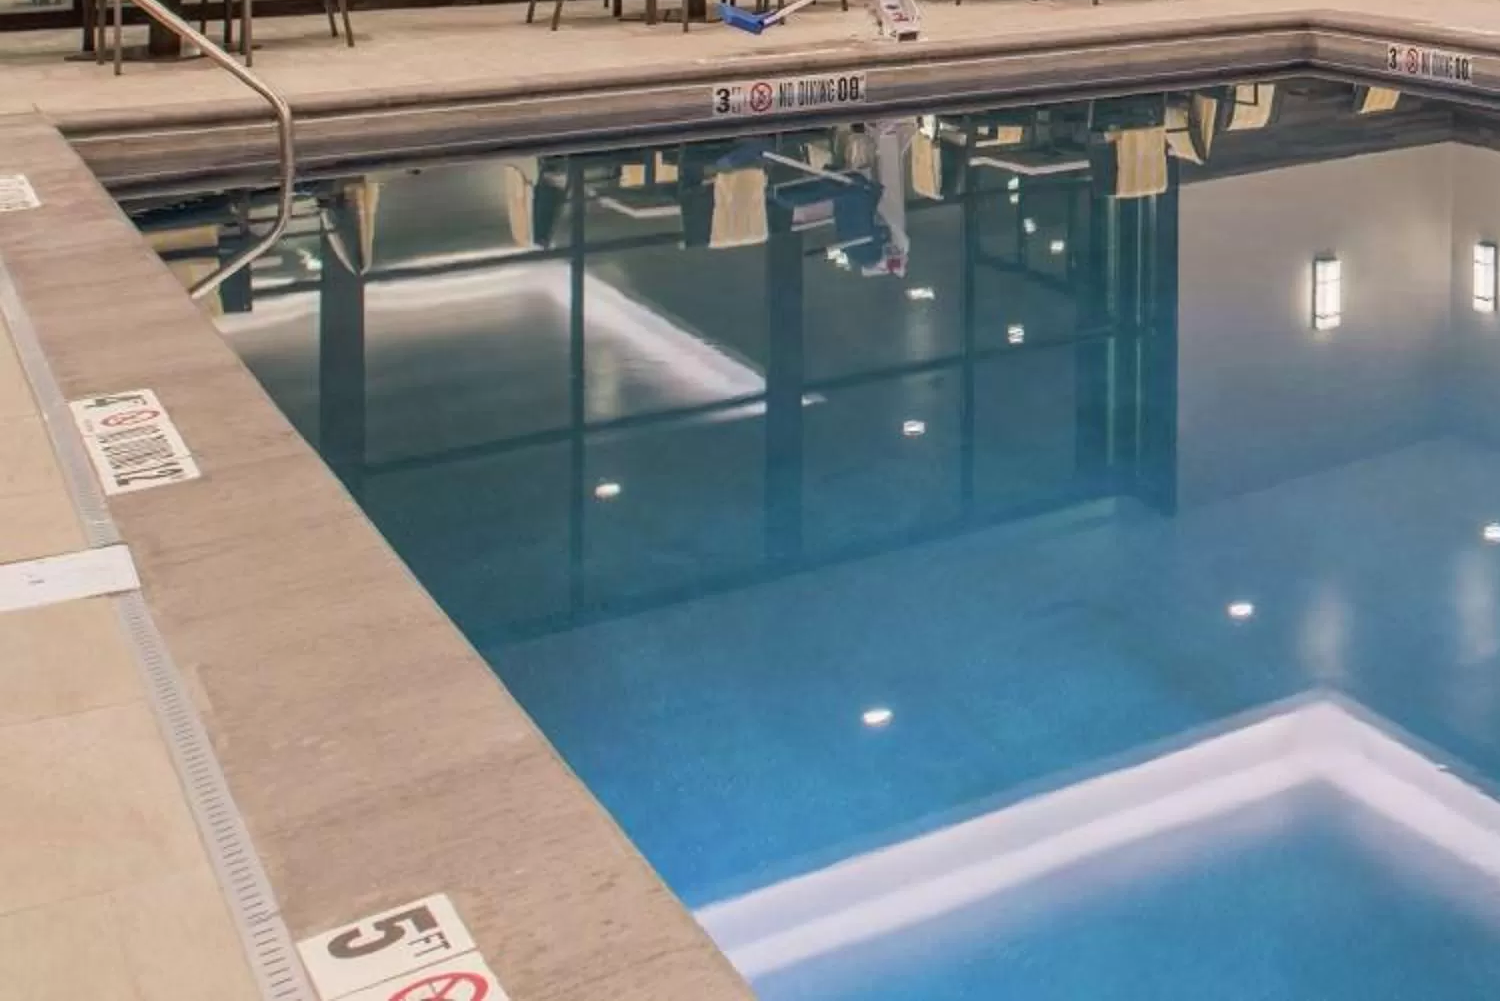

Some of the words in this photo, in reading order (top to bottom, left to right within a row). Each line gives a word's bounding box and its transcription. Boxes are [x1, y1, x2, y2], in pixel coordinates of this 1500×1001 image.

[716, 88, 730, 108] 3
[327, 904, 439, 959] 5
[407, 930, 451, 958] FT
